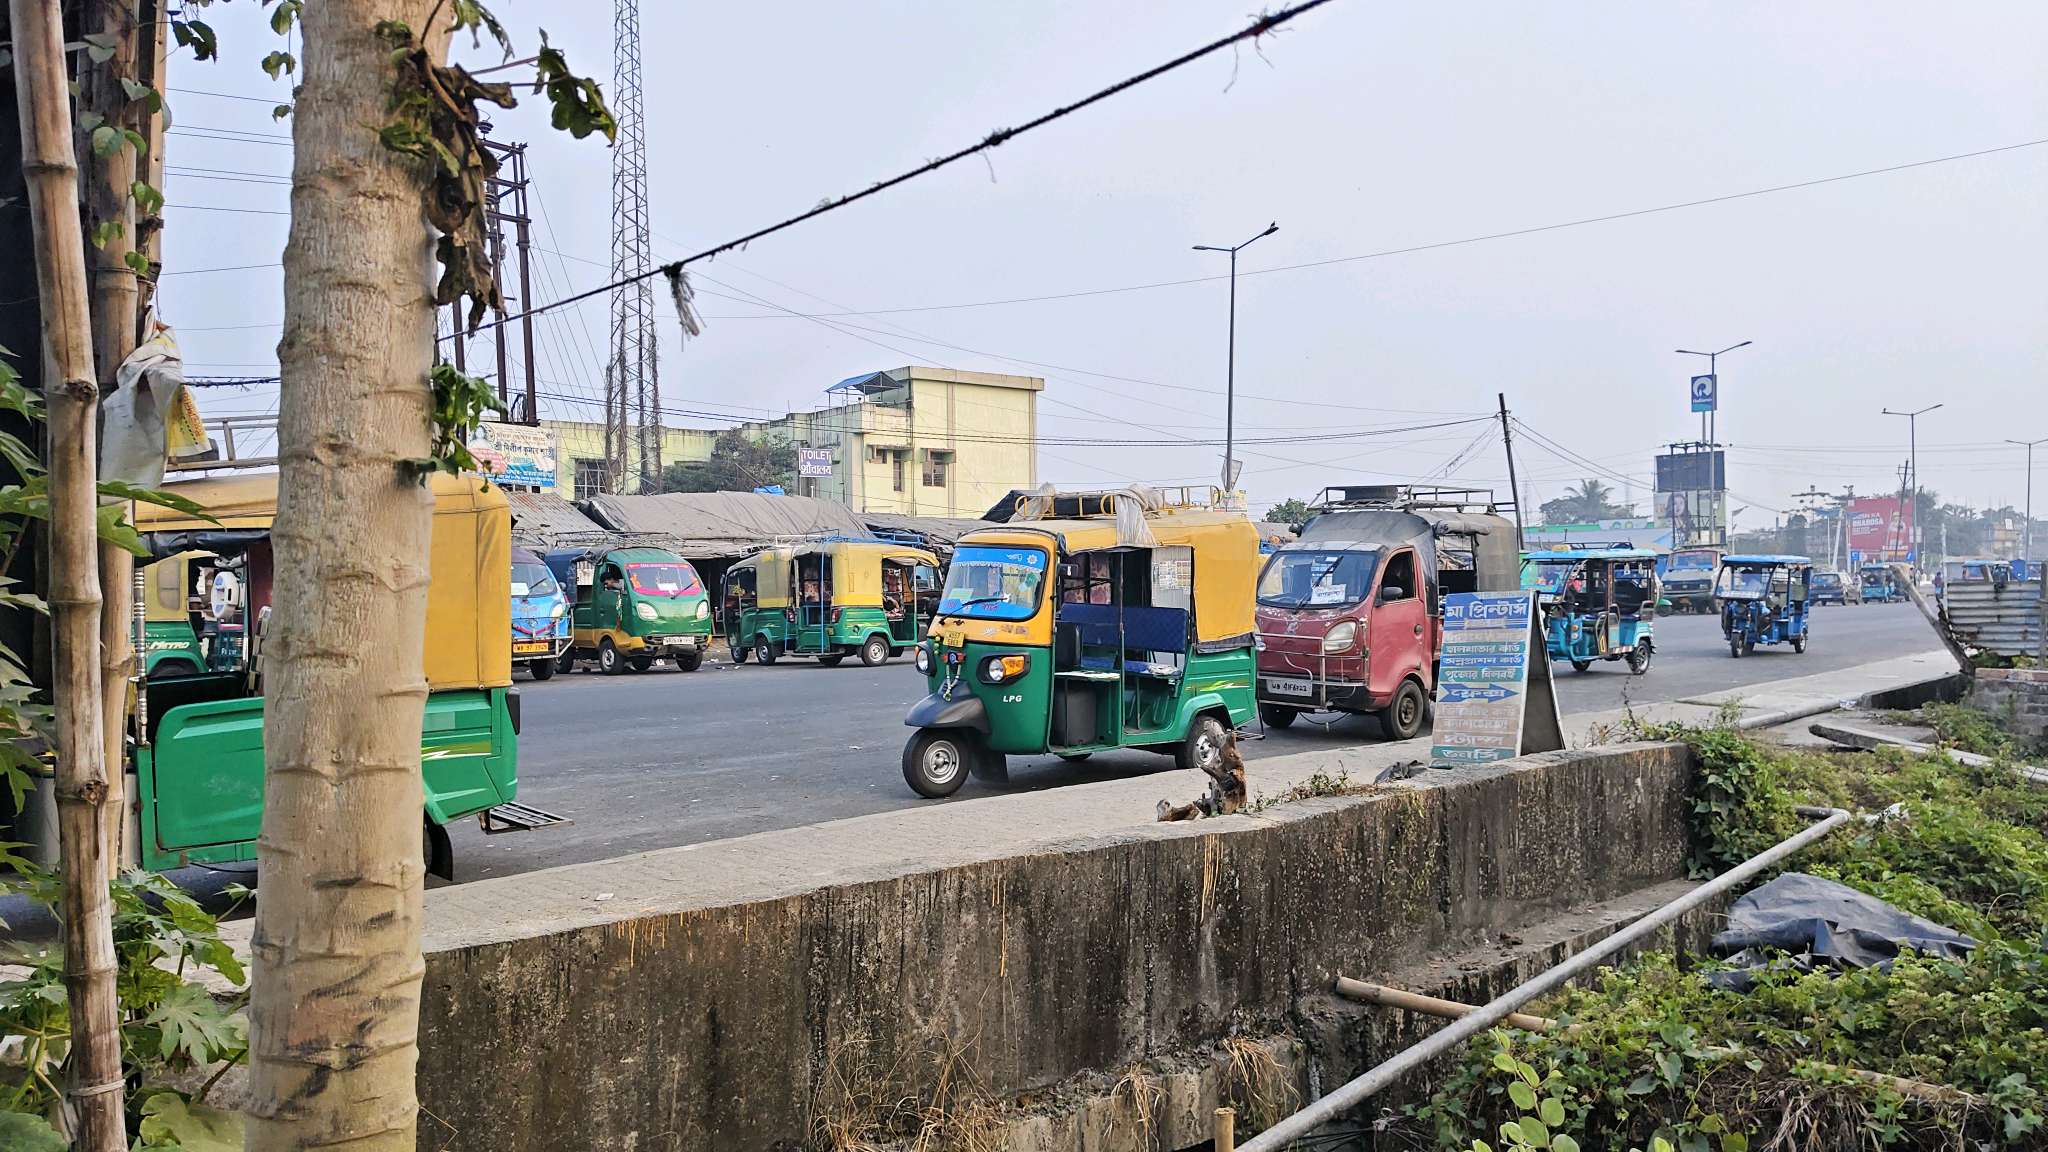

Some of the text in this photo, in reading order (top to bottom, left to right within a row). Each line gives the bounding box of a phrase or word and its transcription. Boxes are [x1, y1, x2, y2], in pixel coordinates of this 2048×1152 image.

[802, 450, 830, 460] TOILET
[1446, 597, 1528, 619] মা প্রিন্টার্স
[1002, 695, 1023, 703] LPG
